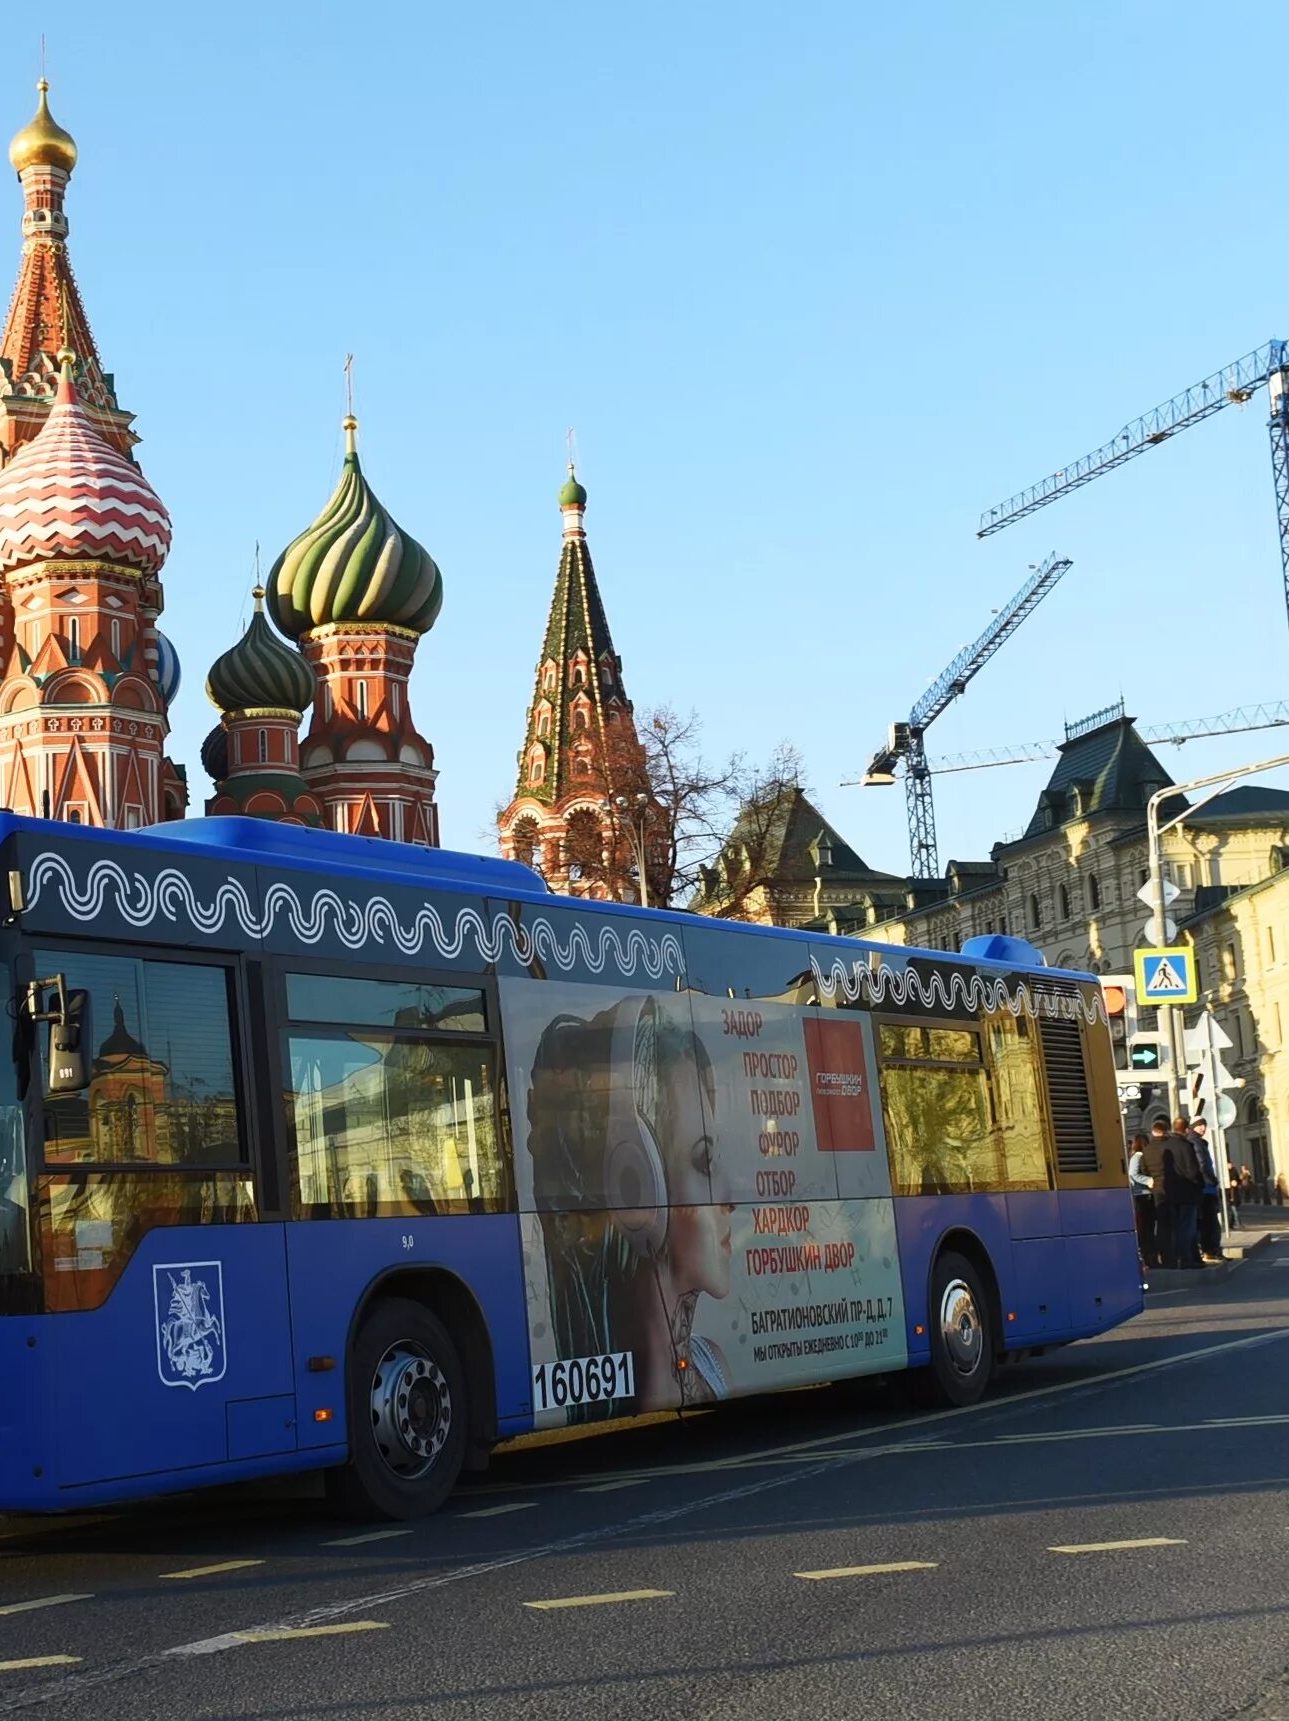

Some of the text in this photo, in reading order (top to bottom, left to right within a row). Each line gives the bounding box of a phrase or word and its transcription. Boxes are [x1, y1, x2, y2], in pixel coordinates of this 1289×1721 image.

[721, 1008, 763, 1040] ЗАДОР
[742, 1051, 799, 1080] ПРОСТОР
[816, 1072, 862, 1085] ГОРБУШКИН
[750, 1089, 800, 1120] ПОДБОР
[758, 1131, 800, 1158] ФУРОР
[755, 1170, 796, 1197] ОТБОР
[752, 1205, 810, 1237] ХАРДКОР
[746, 1242, 855, 1276] ГОРБУШКИН ДВОР
[751, 1297, 849, 1335] БАГРАТИОНОВСКИЙ
[886, 1297, 894, 1318] 7
[753, 1346, 767, 1363] МЫ
[767, 1341, 803, 1361] ОТКРЫТЫ
[803, 1336, 845, 1356] ЕЖЕДНЕВНО
[844, 1334, 850, 1349] С
[864, 1332, 875, 1349] ДО
[534, 1353, 631, 1408] 160691
